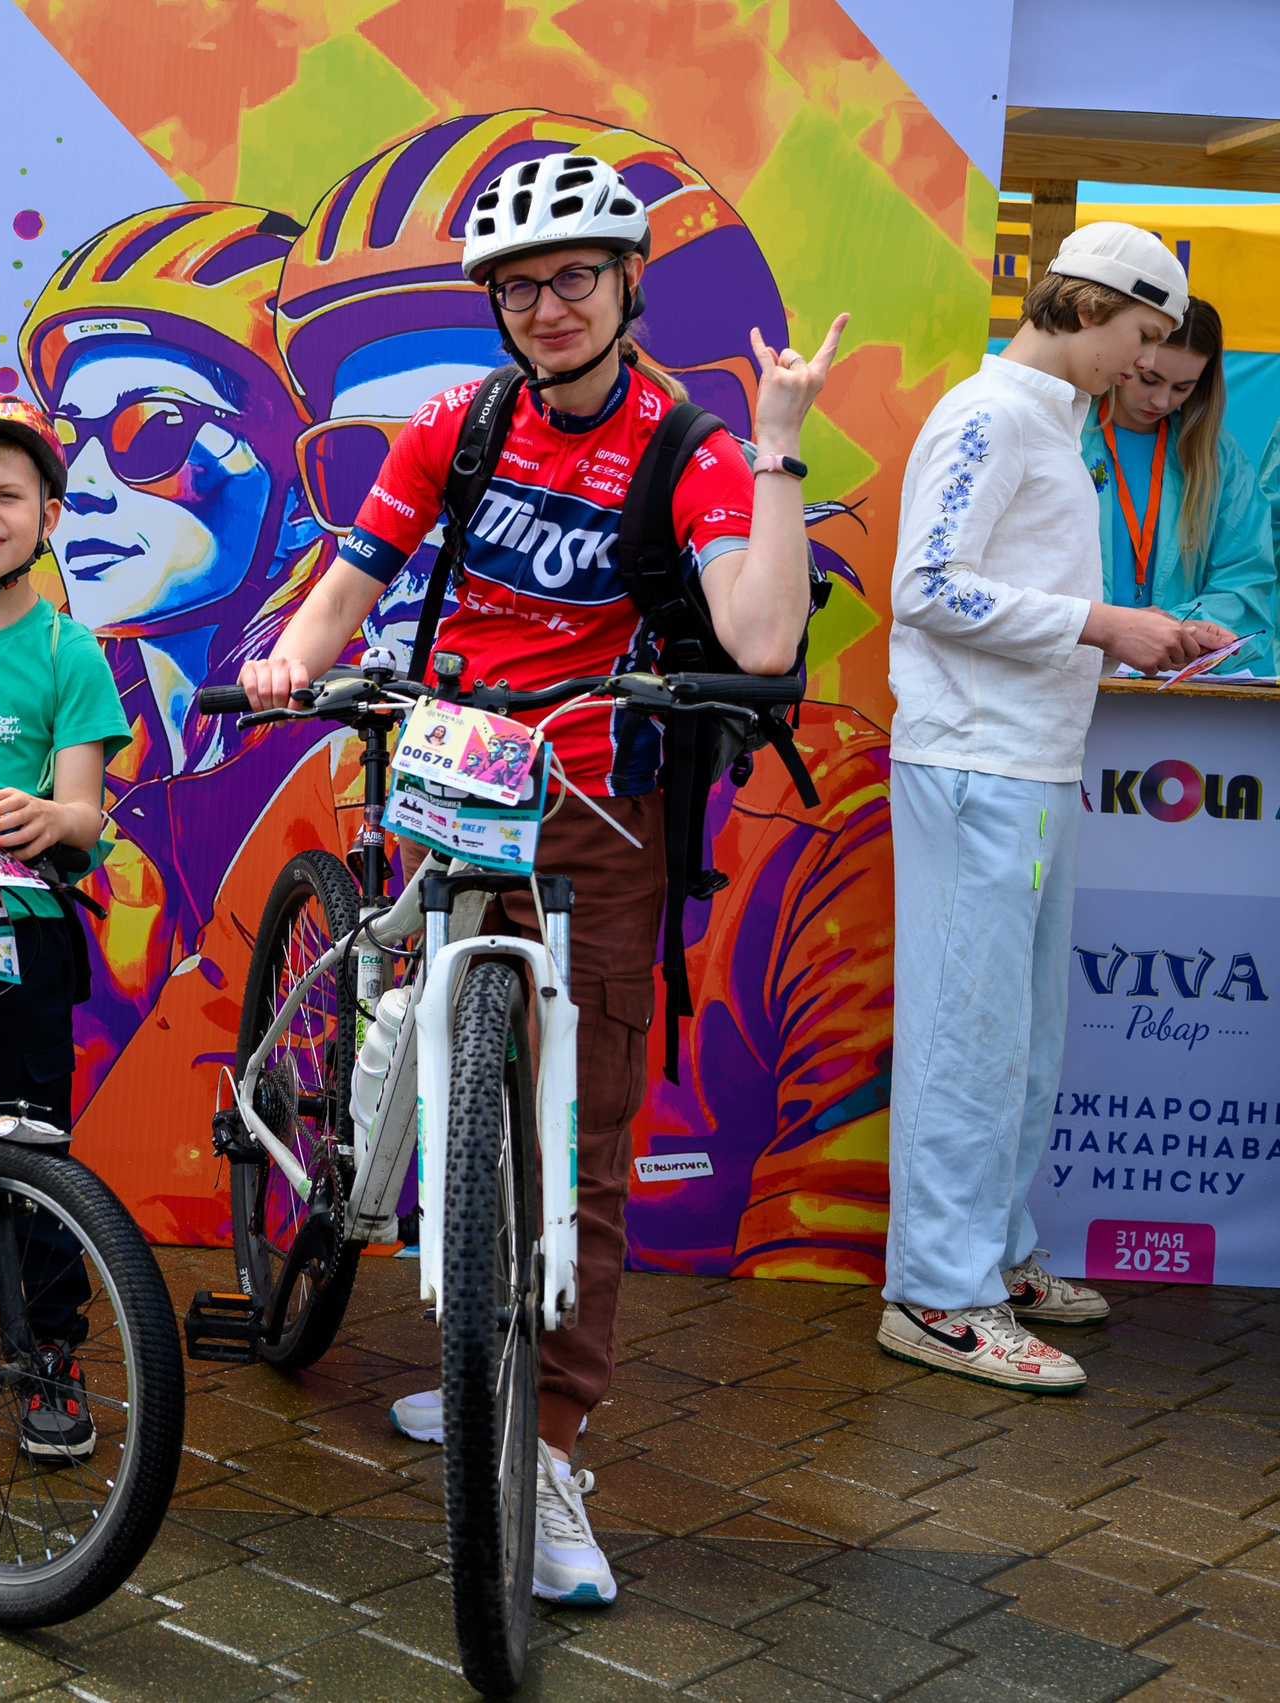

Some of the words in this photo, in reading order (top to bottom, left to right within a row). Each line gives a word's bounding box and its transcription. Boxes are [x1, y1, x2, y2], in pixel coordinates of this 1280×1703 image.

[402, 745, 454, 769] 00678
[1101, 759, 1263, 823] KOLA
[1072, 943, 1271, 1003] VIVA
[1125, 1004, 1210, 1051] Ровар
[1053, 1092, 1280, 1126] ІЖНАРОДН
[1050, 1128, 1280, 1161] ЛАКАРНАВА
[1053, 1164, 1073, 1188] У
[1092, 1166, 1245, 1195] МІНСКУ
[1116, 1230, 1136, 1247] 31
[1145, 1232, 1184, 1249] МАЯ
[1114, 1248, 1190, 1273] 2025
